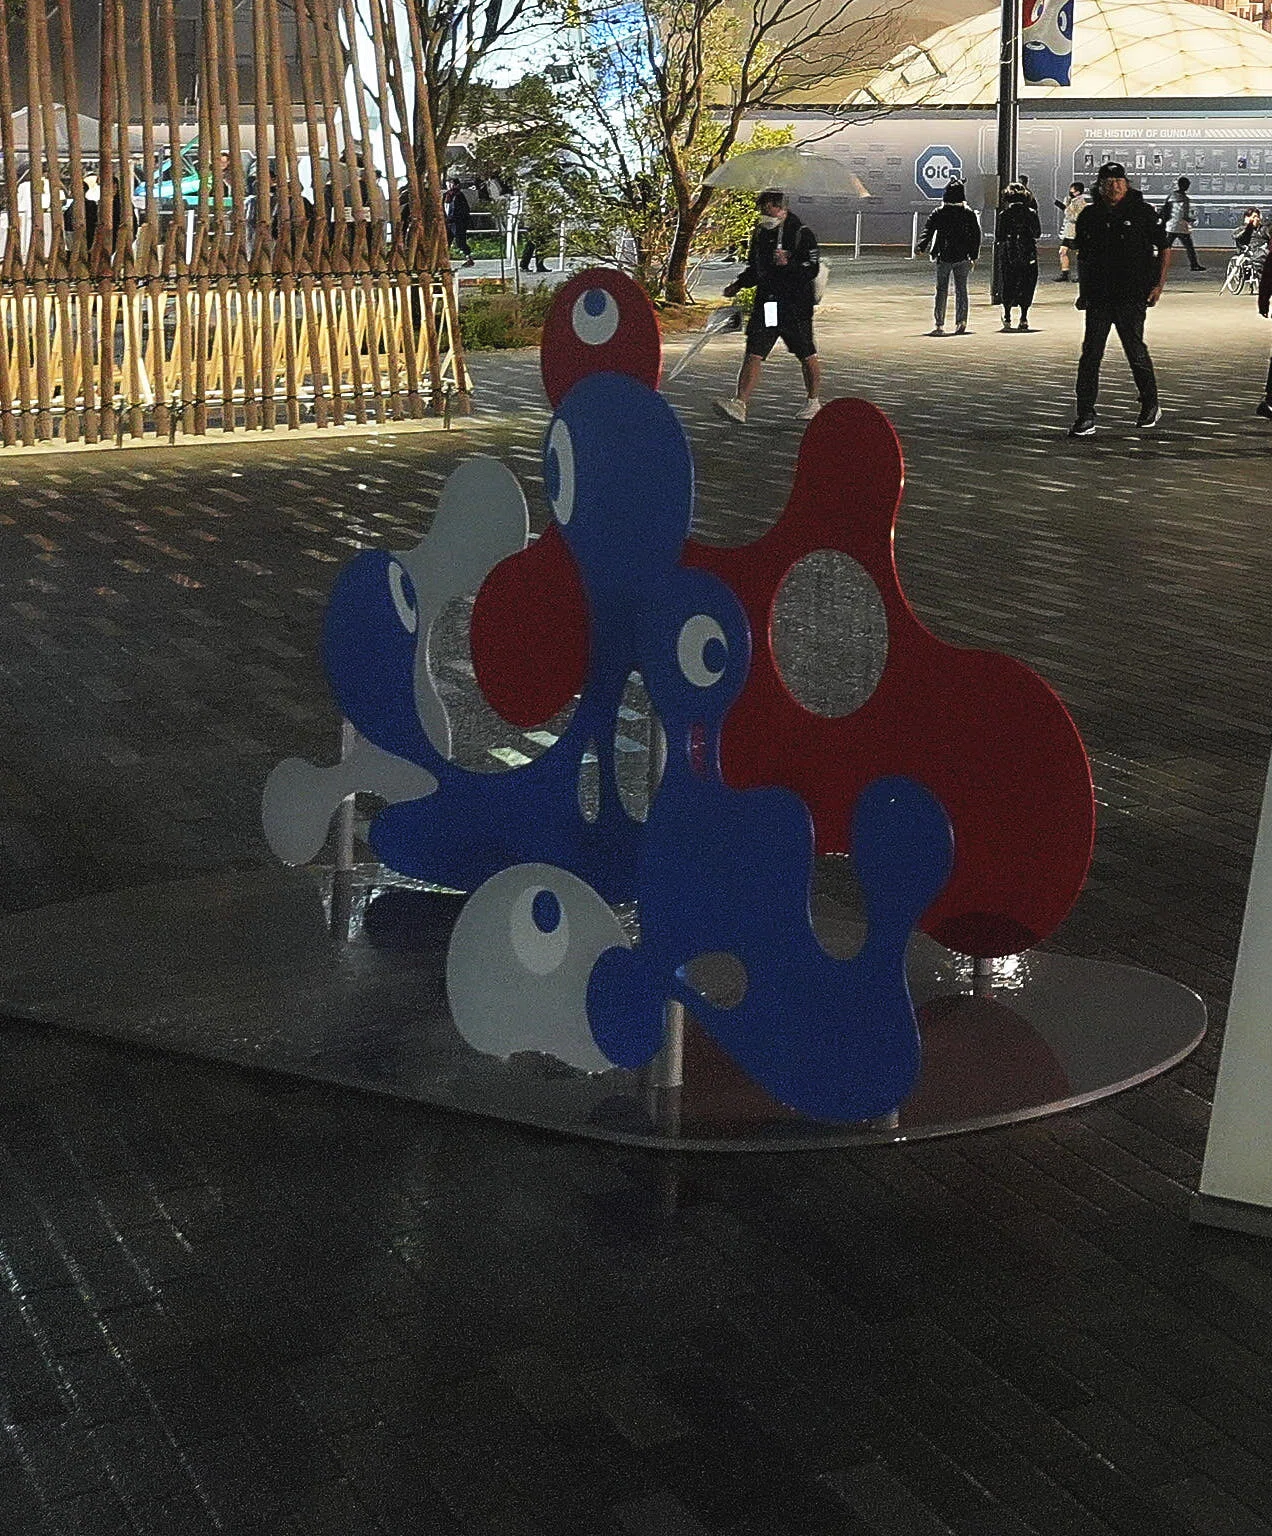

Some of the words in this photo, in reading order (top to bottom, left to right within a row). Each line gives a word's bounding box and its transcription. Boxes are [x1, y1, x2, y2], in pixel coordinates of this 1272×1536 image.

[1084, 128, 1102, 138] THE
[1103, 128, 1143, 138] HISTORY
[1145, 128, 1159, 138] OF
[1160, 128, 1201, 138] GUNDAM
